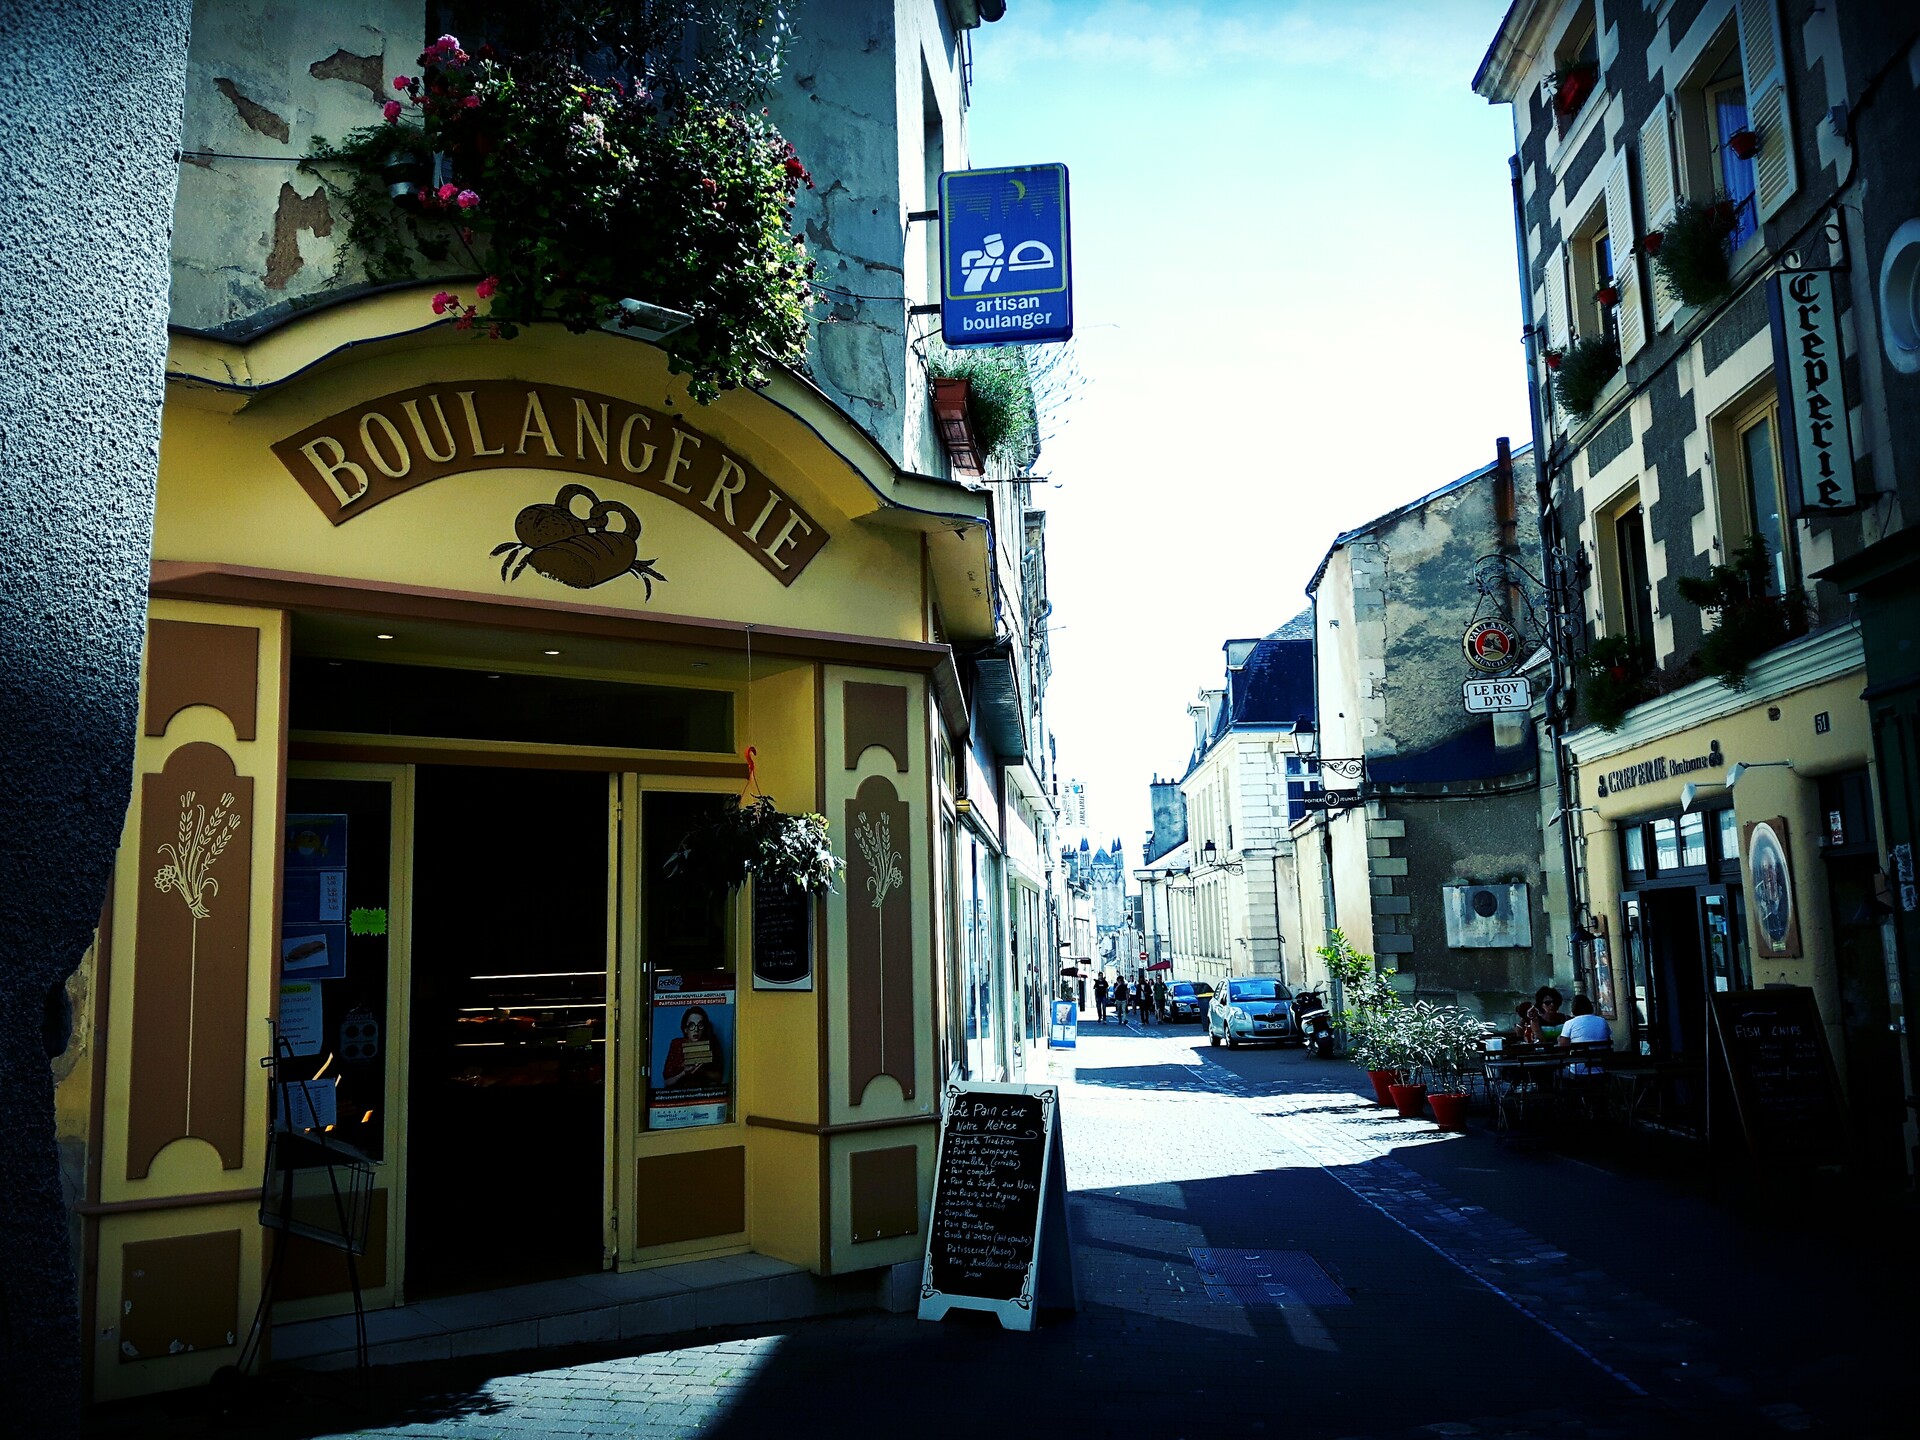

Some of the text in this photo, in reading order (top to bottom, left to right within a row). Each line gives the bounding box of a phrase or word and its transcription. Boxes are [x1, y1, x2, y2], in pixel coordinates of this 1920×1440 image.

[976, 297, 1039, 312] artisan
[963, 312, 1052, 330] boulanger
[1789, 272, 1841, 505] Creperie
[300, 390, 813, 572] BOULANGERIE
[1469, 622, 1515, 642] PAULANER
[1473, 683, 1519, 696] LE ROY
[1484, 695, 1512, 706] D'YS
[1816, 714, 1827, 732] 51
[1669, 755, 1709, 776] Bretonne
[1734, 1024, 1802, 1038] FISH CHIPS
[953, 1101, 969, 1117] Le
[973, 1103, 997, 1117] Pain
[956, 1121, 978, 1132] Notre
[983, 1135, 1015, 1145] Tradition
[950, 1176, 963, 1185] Pain
[966, 1178, 974, 1186] de
[944, 1219, 959, 1228] Pain
